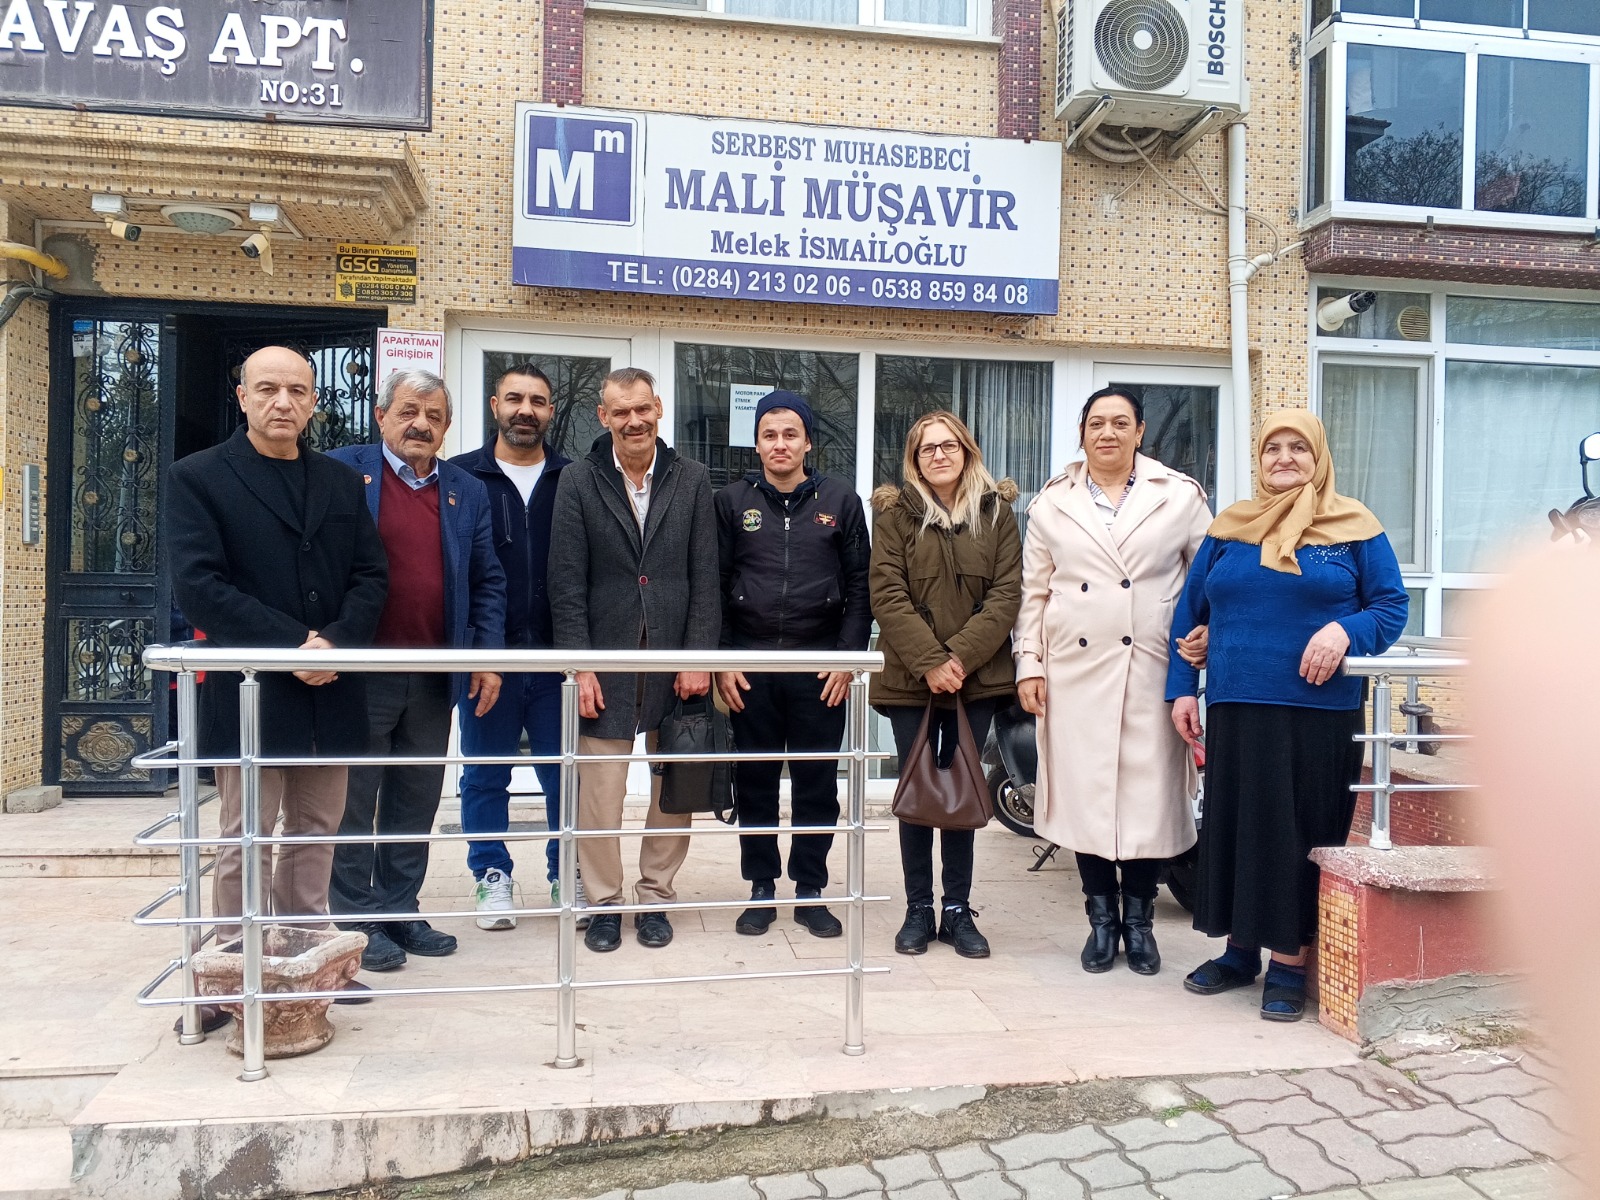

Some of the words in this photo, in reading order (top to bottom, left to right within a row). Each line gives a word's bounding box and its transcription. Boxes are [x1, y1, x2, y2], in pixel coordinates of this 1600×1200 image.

[208, 12, 364, 73] APT.
[1208, 0, 1226, 75] BOSCH
[260, 79, 342, 106] NO:31
[711, 131, 816, 161] SERBEST
[823, 139, 971, 172] MUHASEBECİ
[665, 161, 786, 217] MALİ
[802, 169, 1018, 236] MÜŞAVİR
[352, 247, 380, 255] Binanın
[380, 248, 414, 256] Yönetimi
[710, 230, 790, 258] Melek
[799, 227, 967, 267] İSMAİLOĞLU
[339, 256, 379, 273] GSG
[373, 275, 413, 283] Yapılmaktadır
[607, 260, 664, 285] TEL:
[672, 265, 740, 295] (0284)
[747, 271, 787, 293] 213
[793, 273, 819, 295] 02
[825, 275, 851, 296] 06
[871, 277, 922, 300] 0538
[928, 280, 966, 301] 859
[972, 283, 998, 303] 84
[1004, 284, 1029, 305] 08
[382, 336, 439, 347] APARTMAN
[386, 347, 434, 360] GİRİŞİDİR
